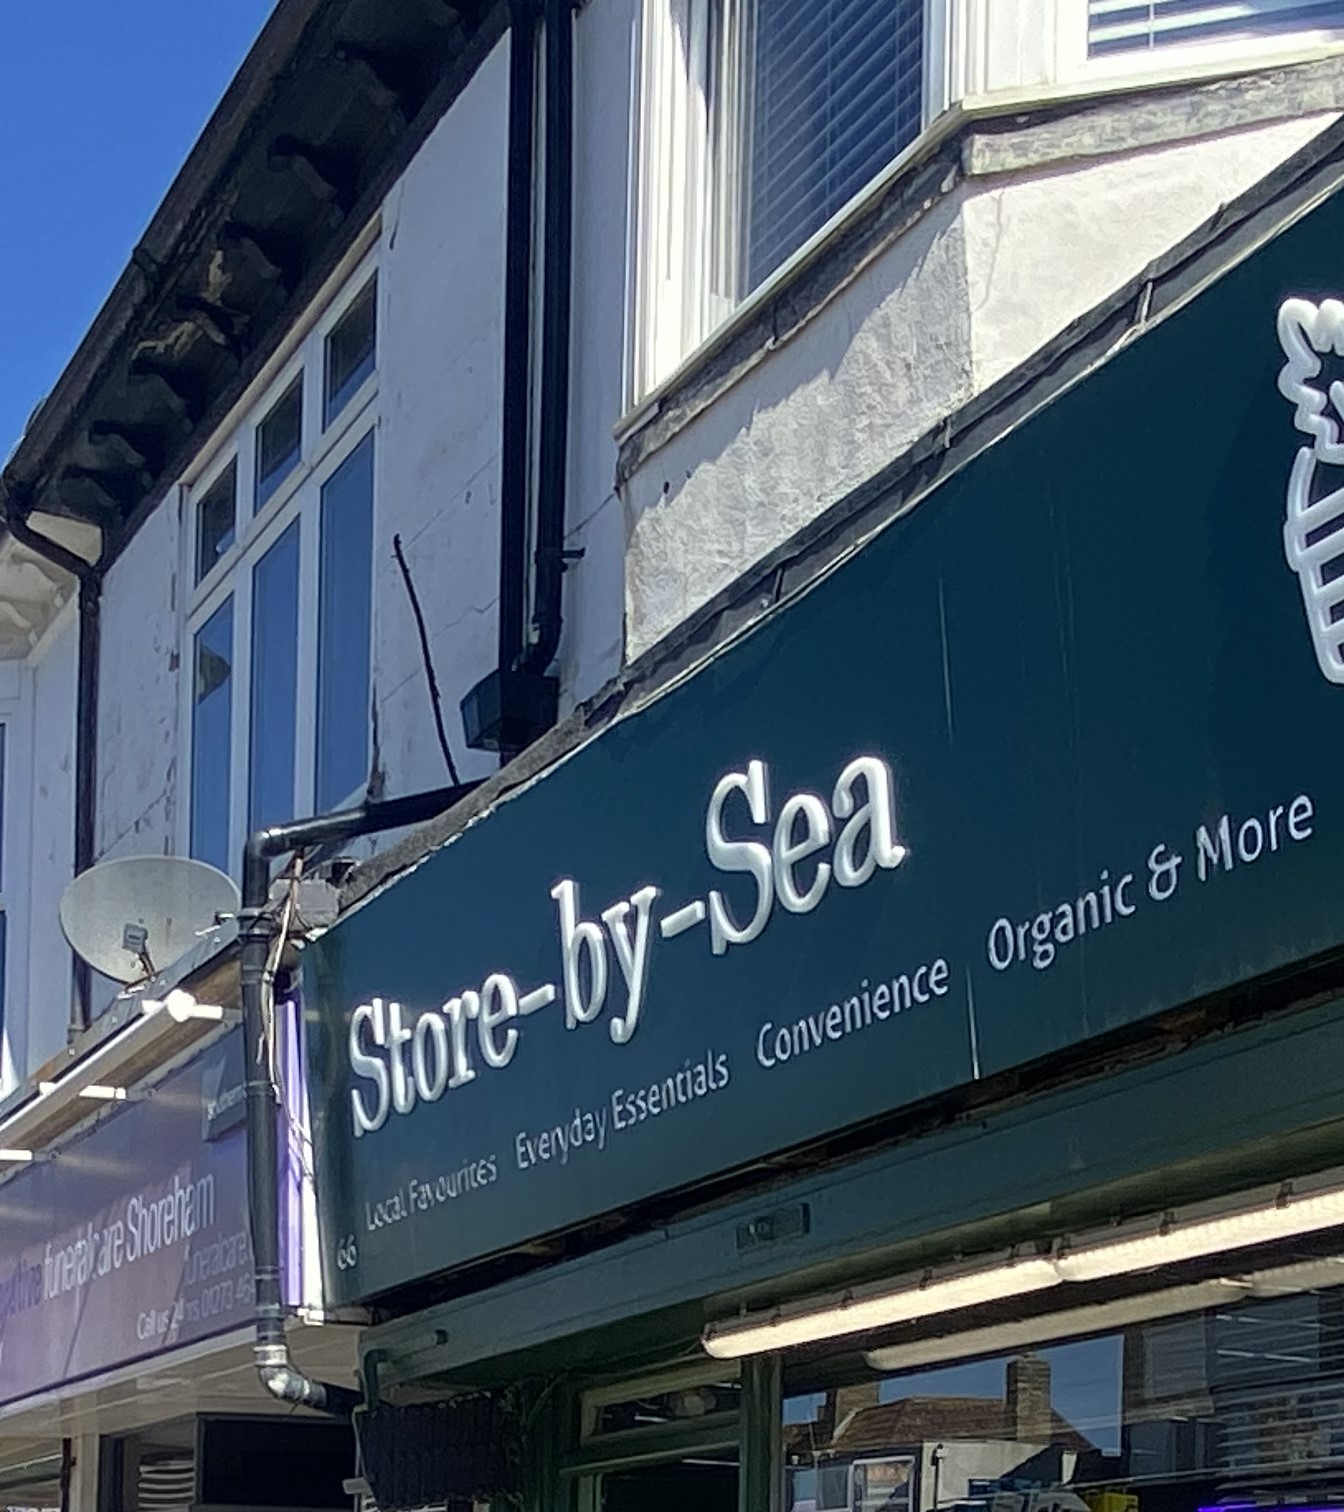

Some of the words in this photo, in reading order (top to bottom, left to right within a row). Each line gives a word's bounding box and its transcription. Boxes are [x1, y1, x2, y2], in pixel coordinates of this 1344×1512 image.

[351, 756, 907, 1136] Store-by-Sea
[365, 1188, 408, 1231] Local
[408, 1154, 497, 1217] Favourites
[515, 1106, 607, 1171] Everyday
[611, 1050, 729, 1131] Essentials
[757, 956, 950, 1070] Convenience
[988, 868, 1136, 971] Organic
[1147, 844, 1182, 901] &
[1196, 794, 1315, 881] More
[126, 1174, 214, 1263] Shoreham
[336, 1233, 358, 1271] 66
